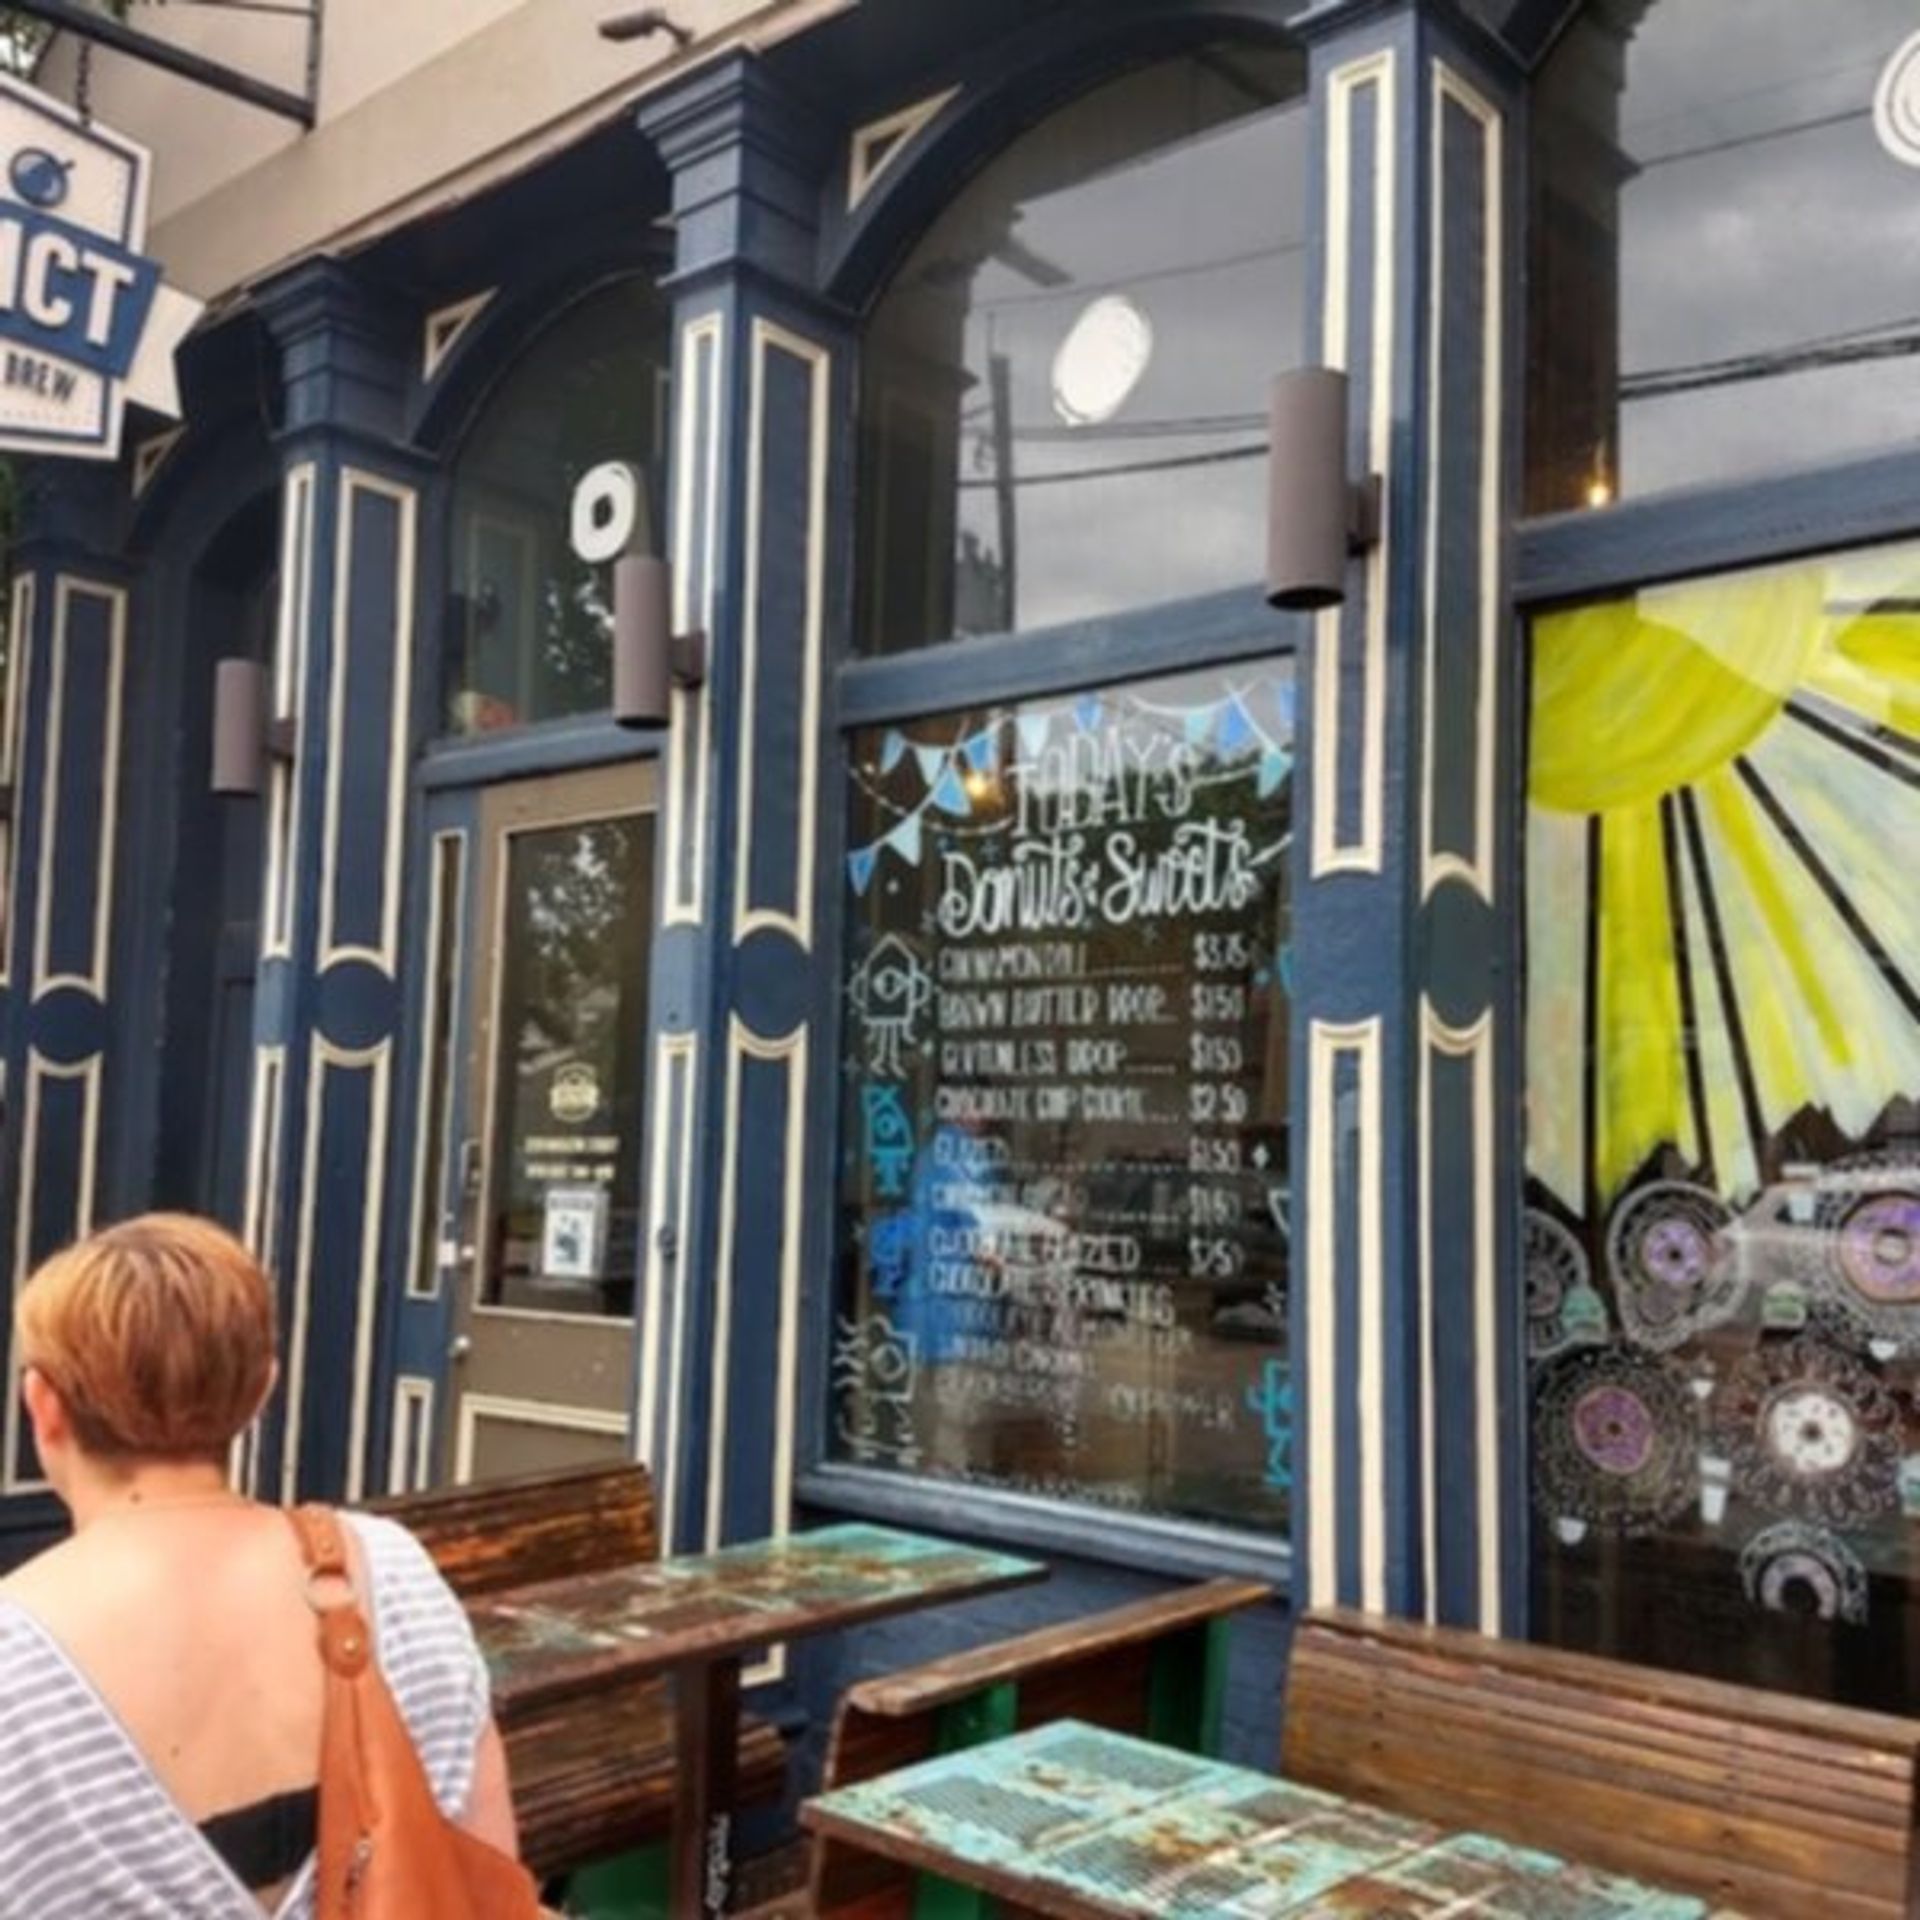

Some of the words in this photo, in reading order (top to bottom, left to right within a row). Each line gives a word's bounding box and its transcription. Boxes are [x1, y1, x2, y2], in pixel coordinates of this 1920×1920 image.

[5, 350, 79, 404] BREW
[1006, 722, 1199, 838] TODAY'S
[938, 836, 1084, 937] Donuts
[1044, 1232, 1141, 1269] AZED
